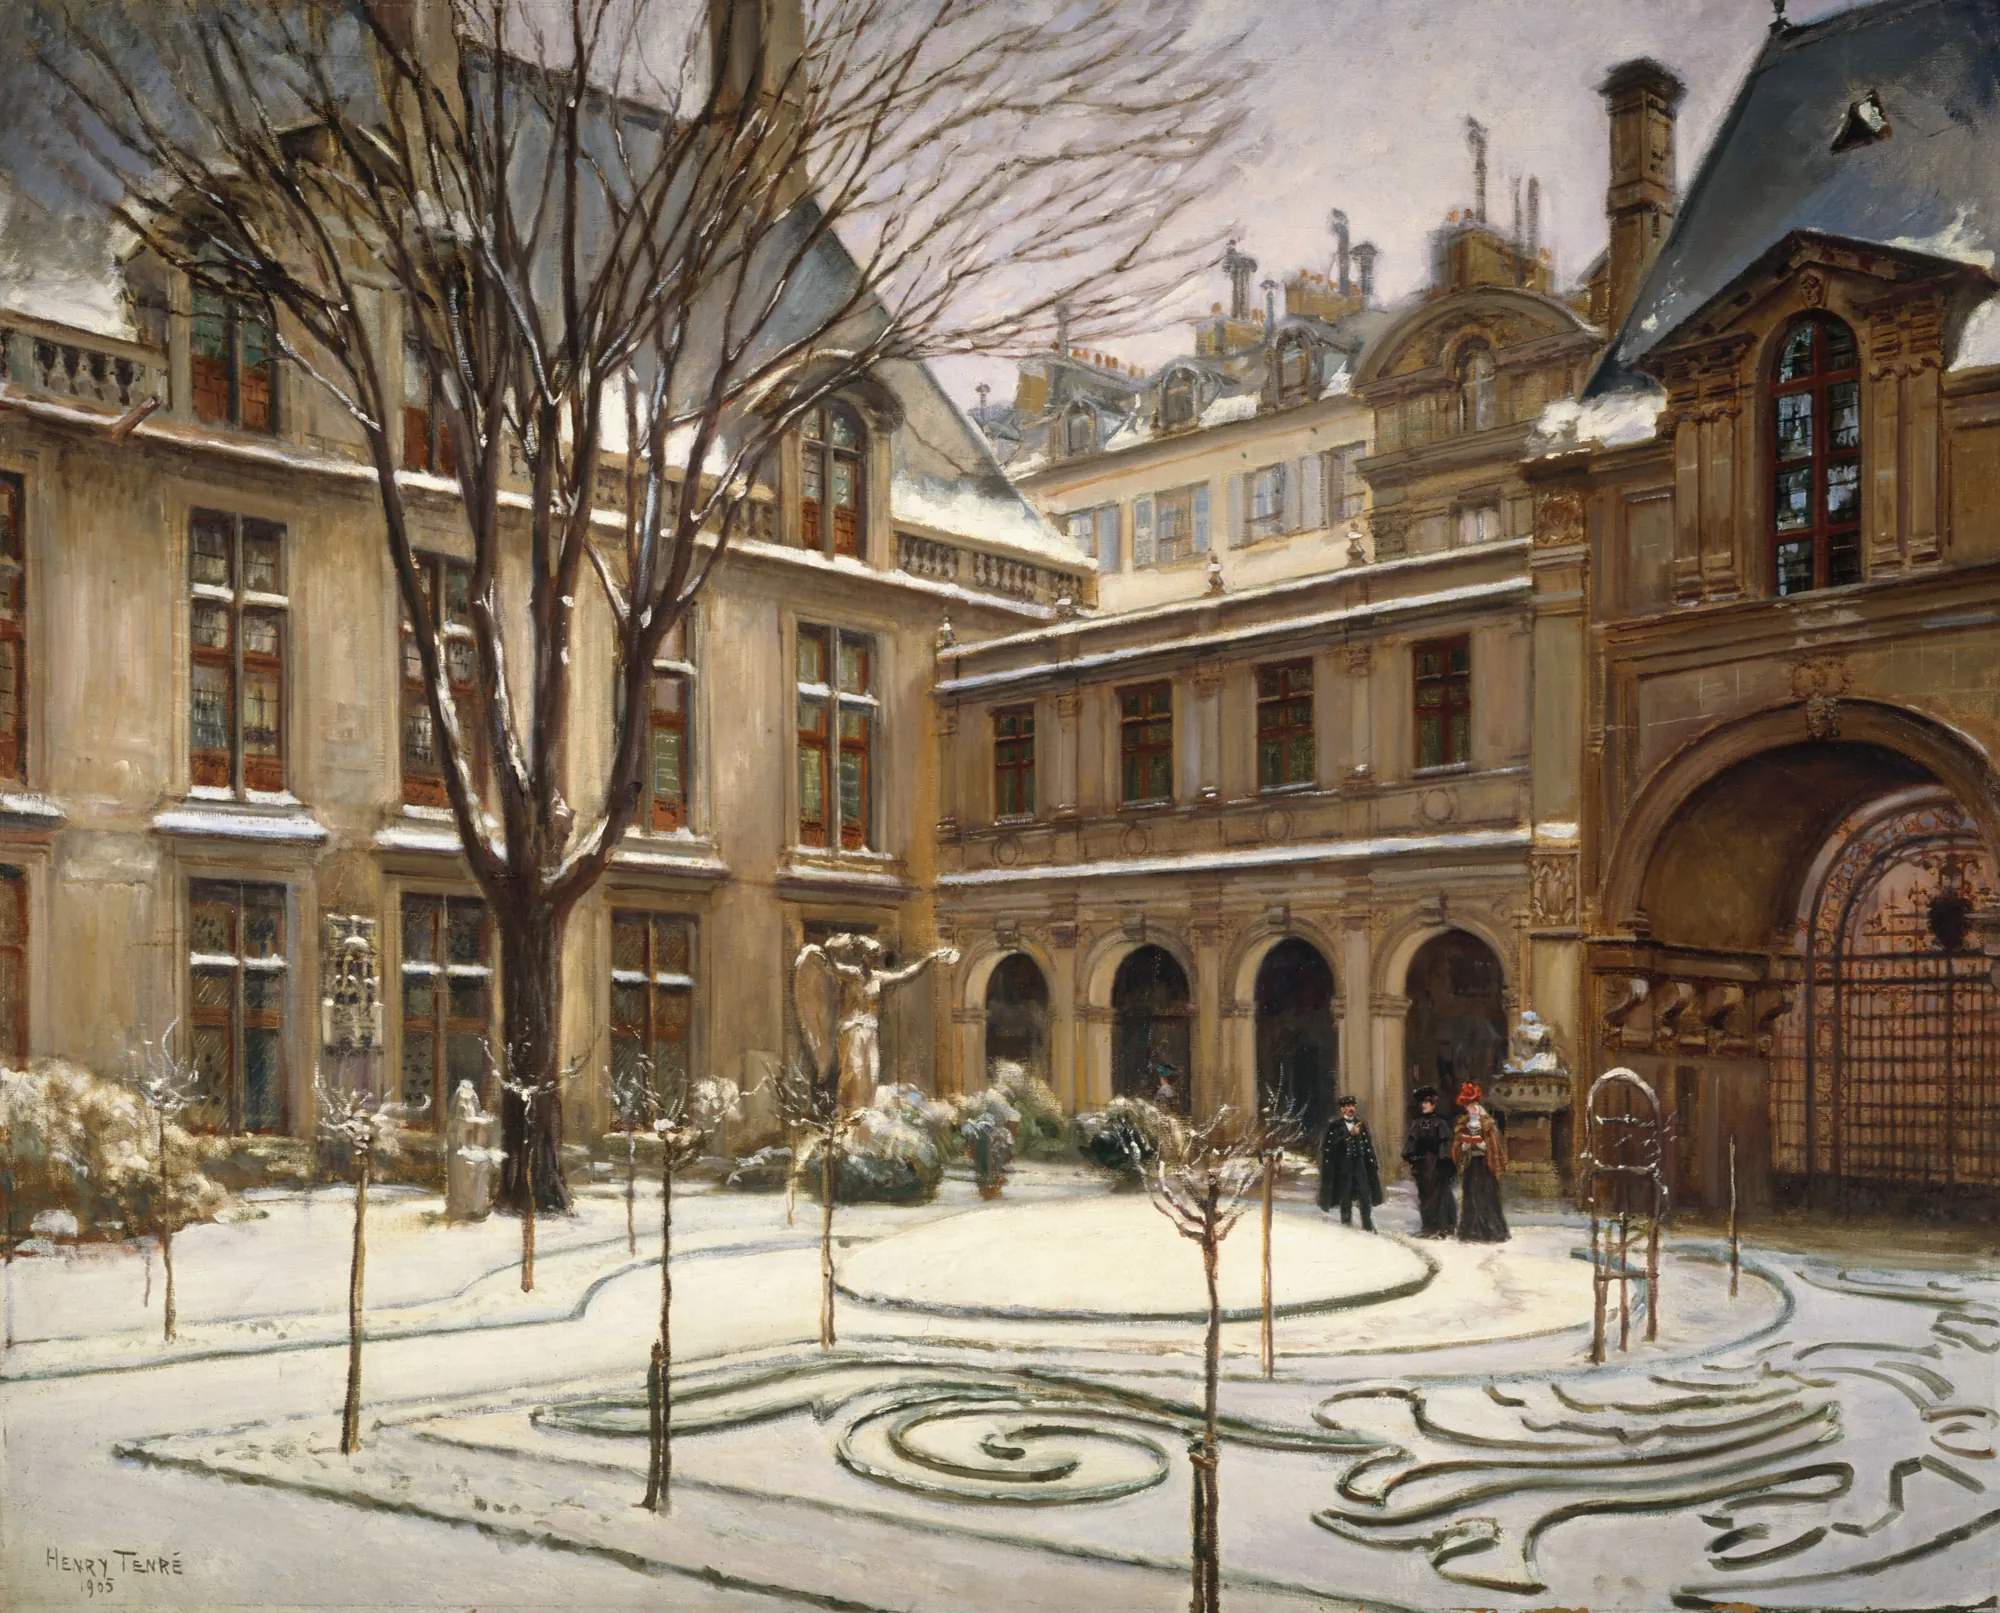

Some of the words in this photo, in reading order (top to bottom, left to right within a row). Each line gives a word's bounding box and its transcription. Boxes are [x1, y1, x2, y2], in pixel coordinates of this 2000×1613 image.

[46, 1548, 107, 1578] HENRY
[112, 1549, 184, 1576] TENRÉ
[80, 1578, 115, 1598] 1905
